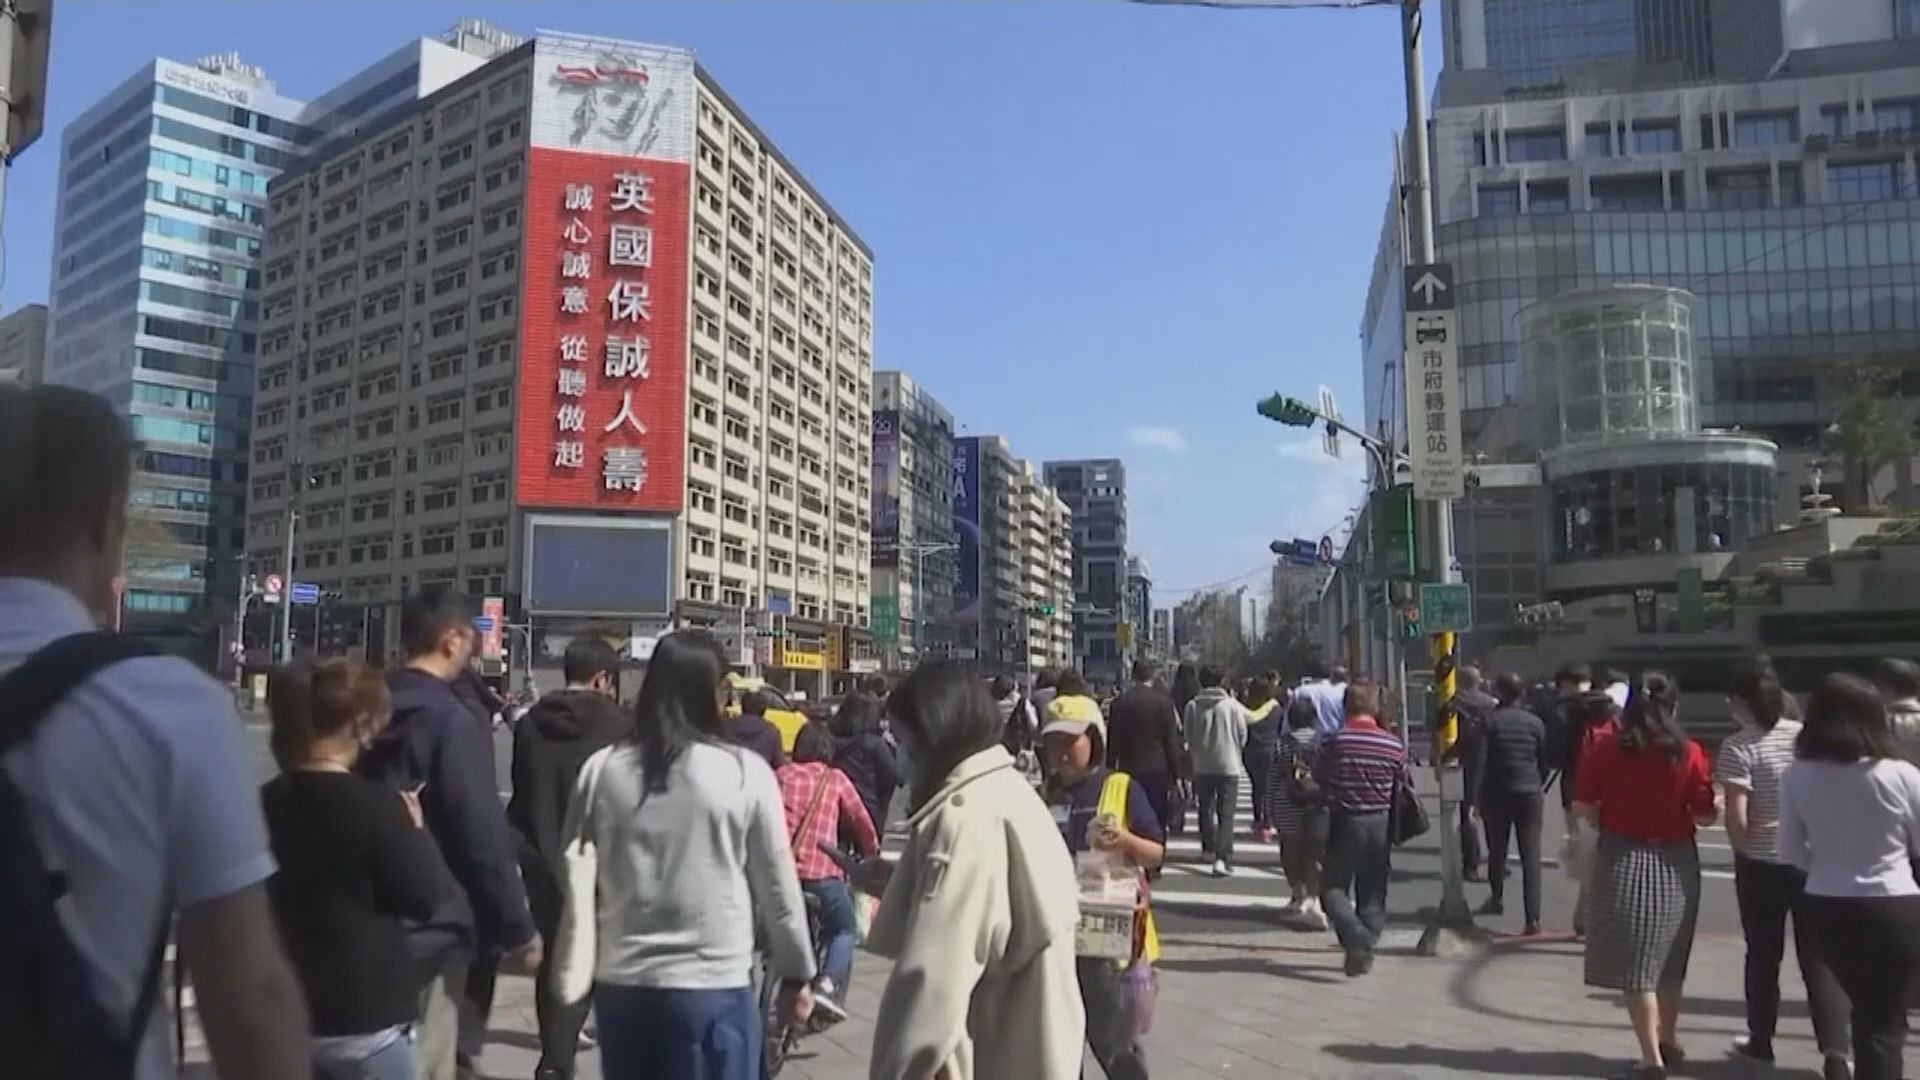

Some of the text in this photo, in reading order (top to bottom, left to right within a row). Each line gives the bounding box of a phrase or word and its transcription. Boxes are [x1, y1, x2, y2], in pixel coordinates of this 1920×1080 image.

[555, 183, 593, 468] 誠心誠意 從聽做起
[603, 171, 653, 491] 英國保誠人壽
[1422, 350, 1448, 454] 市府轉運站
